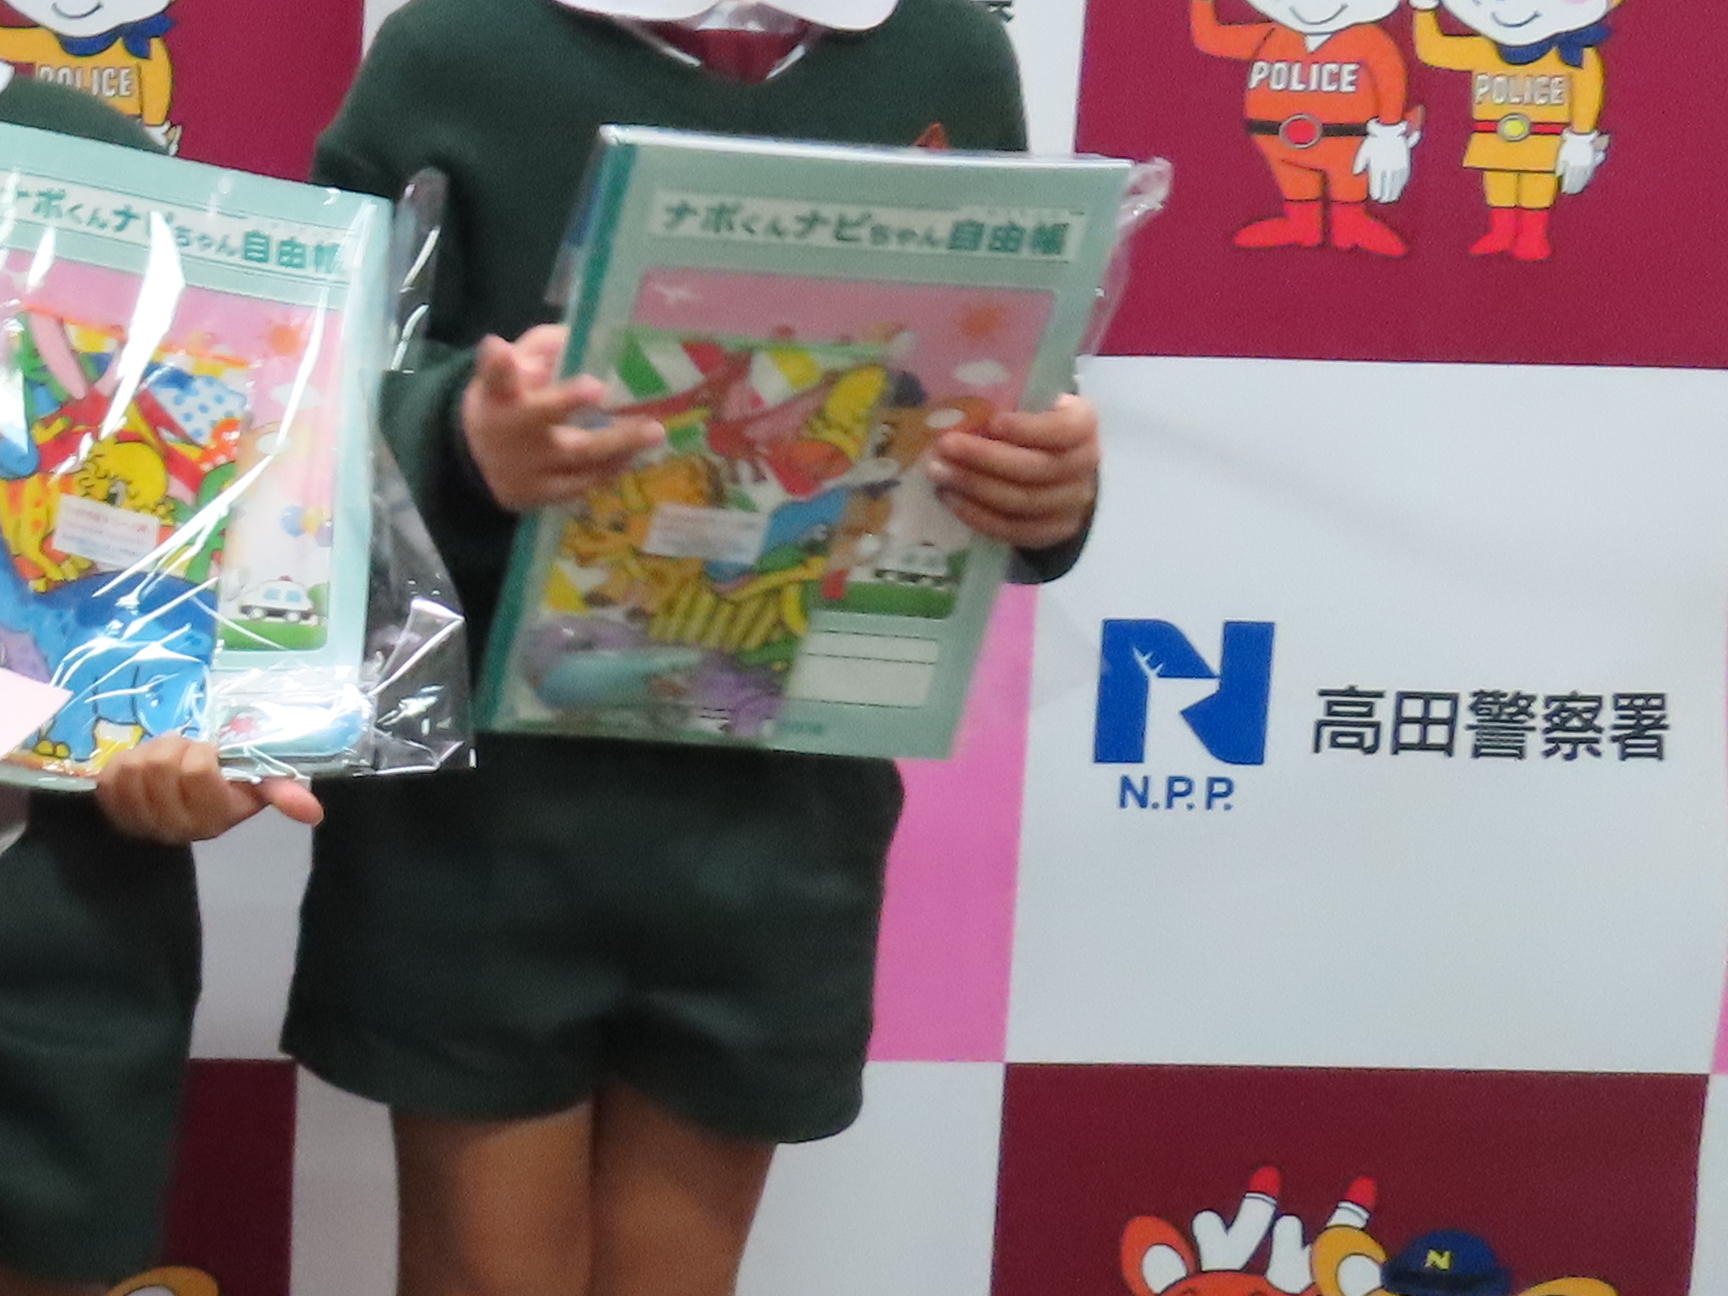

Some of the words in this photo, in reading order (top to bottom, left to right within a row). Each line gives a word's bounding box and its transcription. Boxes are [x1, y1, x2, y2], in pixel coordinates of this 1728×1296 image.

[1248, 60, 1361, 93] POLICE
[1475, 72, 1567, 106] POLICE
[0, 186, 343, 274] ポくんナちゃん自由帳
[1313, 685, 1670, 762] 高田警察署
[1118, 775, 1236, 811] N.P.P.
